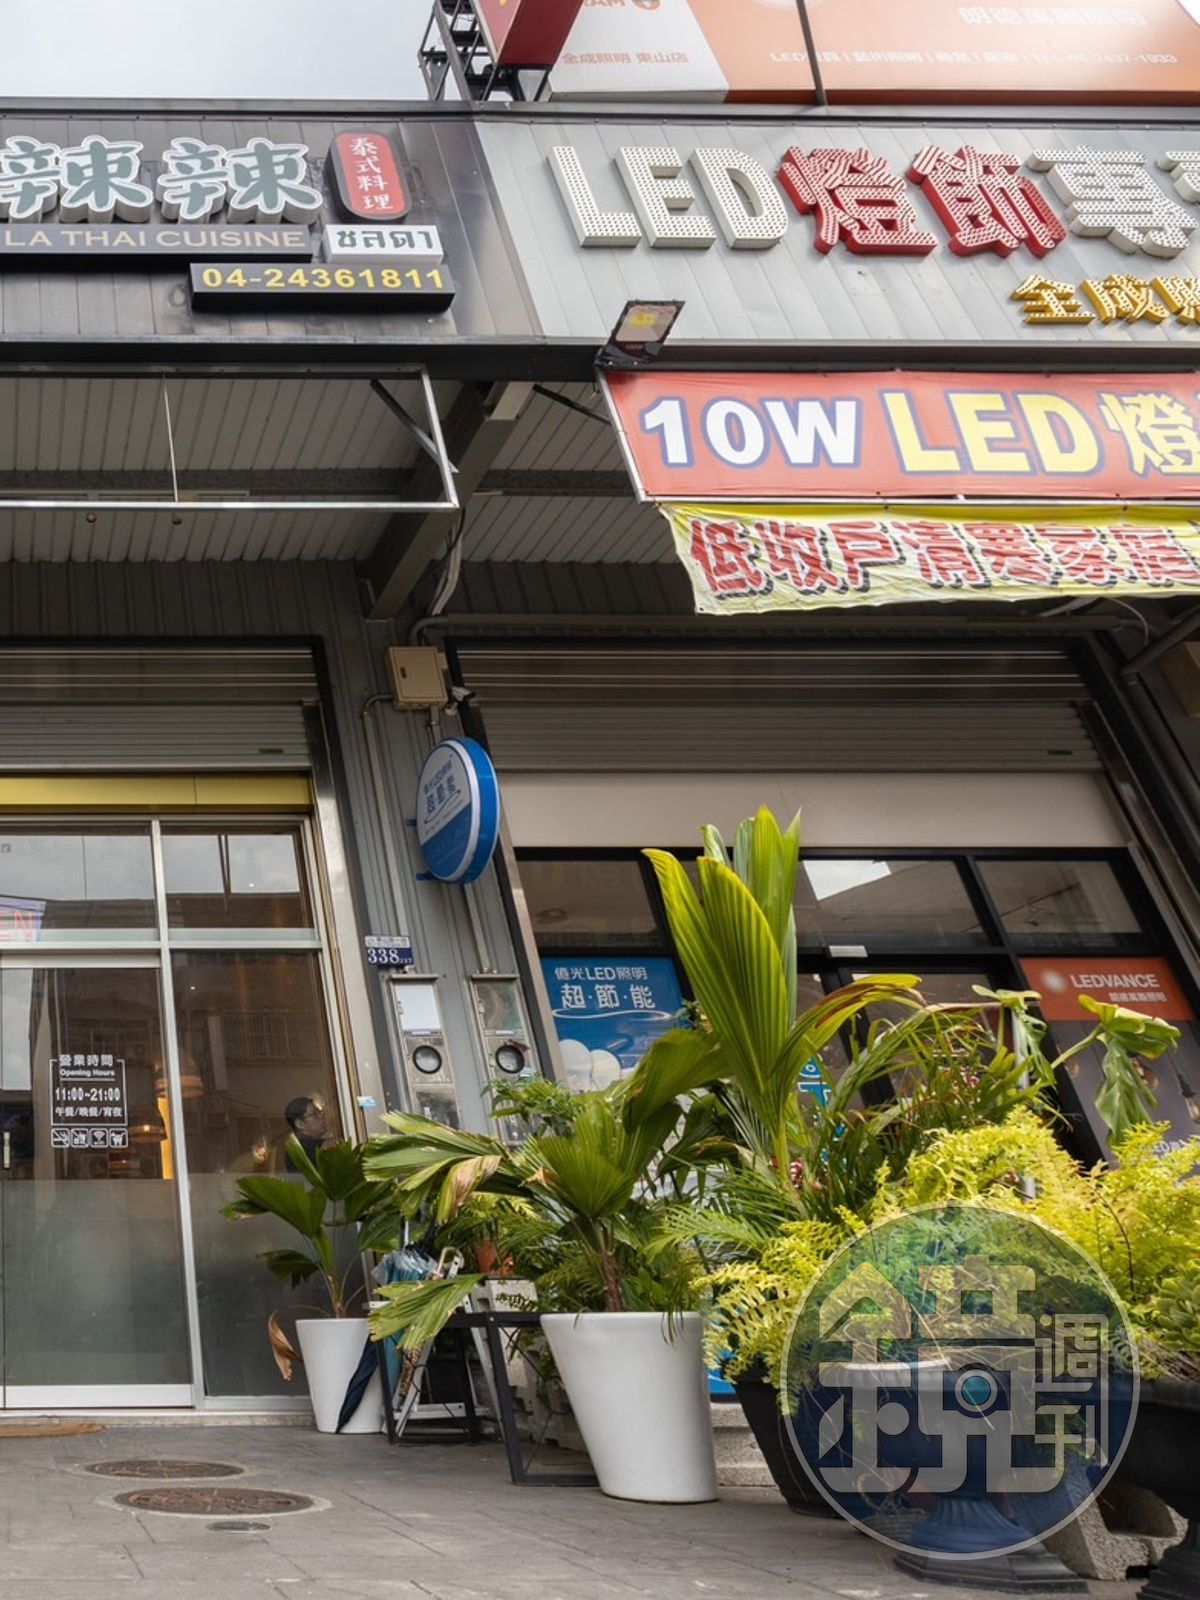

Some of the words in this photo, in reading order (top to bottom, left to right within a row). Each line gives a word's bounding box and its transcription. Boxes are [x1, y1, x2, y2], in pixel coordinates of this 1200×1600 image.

[349, 136, 394, 210] 泰式料理
[4, 230, 53, 246] LA
[61, 230, 147, 247] THAI
[156, 231, 306, 247] CUISINE
[337, 230, 434, 249] ชลดา
[202, 268, 445, 289] 04-24361811
[641, 397, 860, 466] 10W
[367, 948, 400, 964] 338
[554, 966, 649, 981] 億光LED照明
[1070, 973, 1161, 988] LEDVANCE
[59, 1054, 114, 1067] 營業時間
[59, 1069, 91, 1077] Opening
